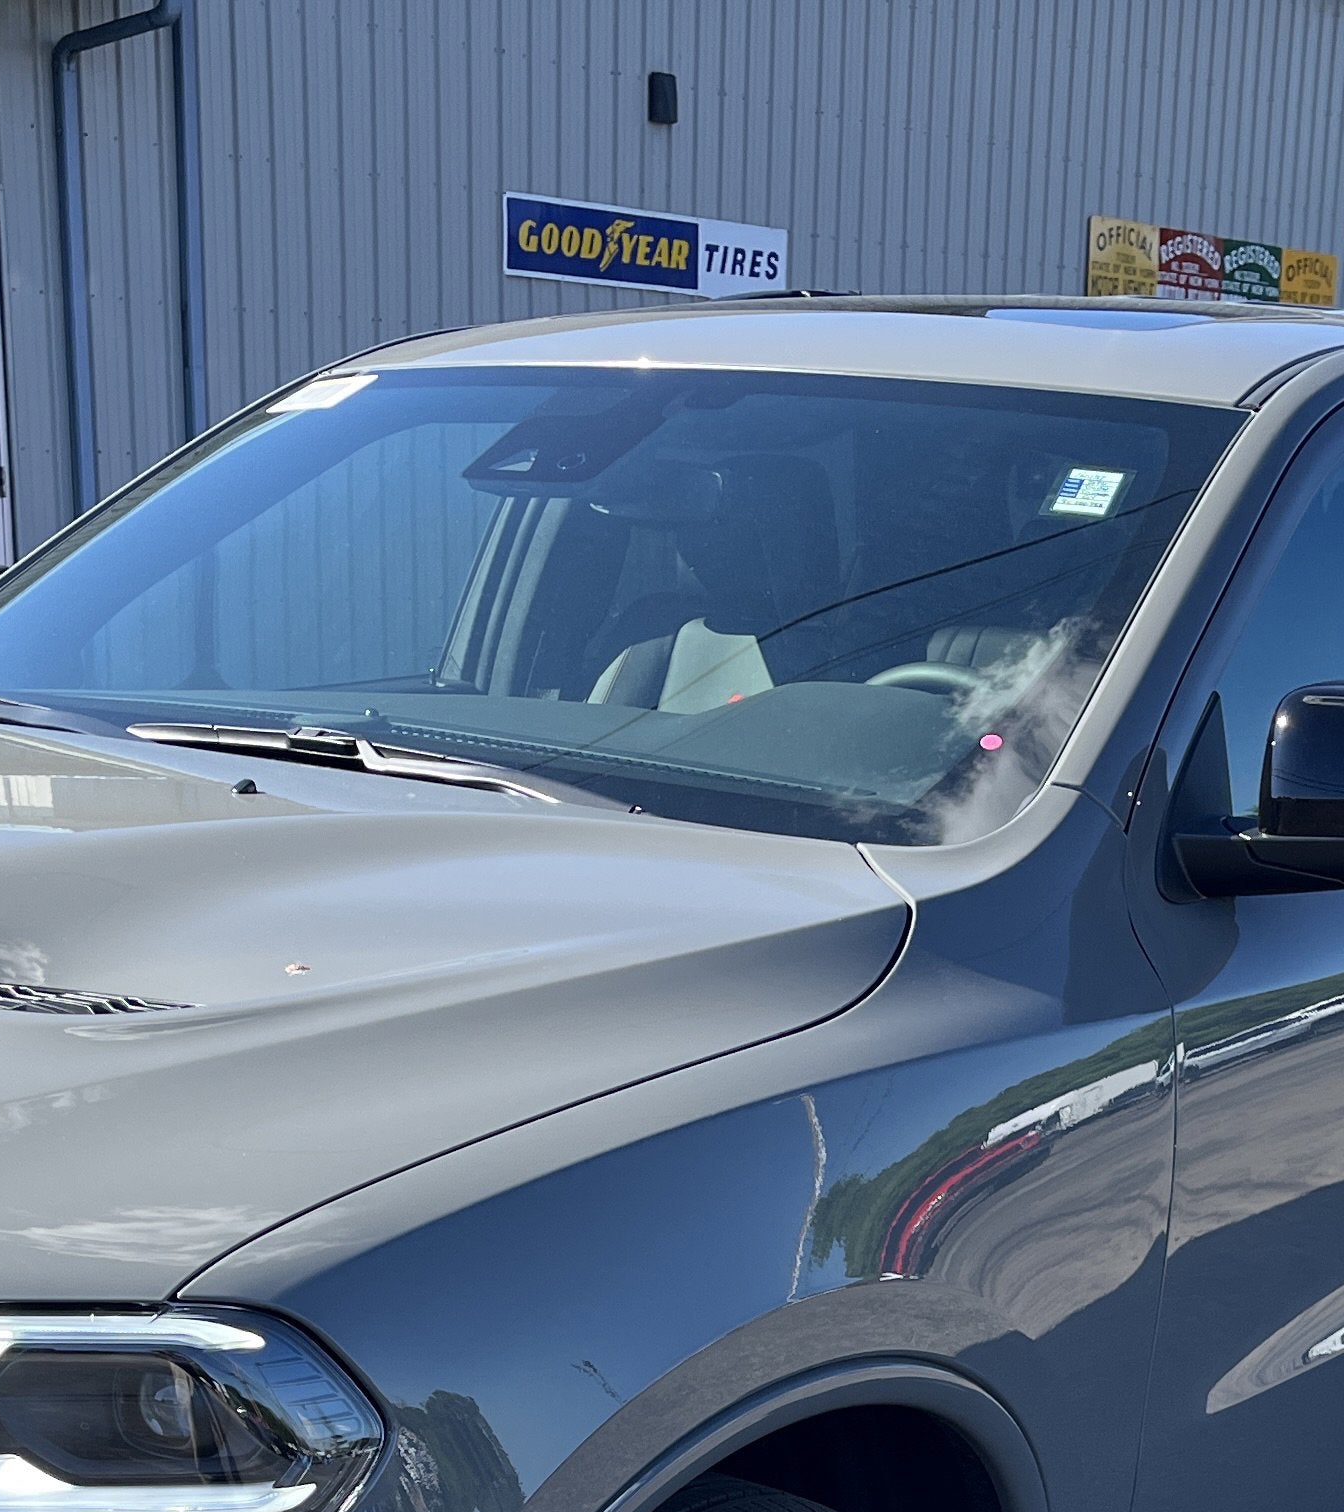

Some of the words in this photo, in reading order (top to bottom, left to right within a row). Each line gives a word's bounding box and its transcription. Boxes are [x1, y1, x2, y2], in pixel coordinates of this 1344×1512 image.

[1097, 224, 1154, 261] OFFICIAL
[1160, 234, 1222, 271] REGISTERED
[705, 243, 779, 280] TIRES
[1223, 245, 1281, 279] REGISTERED
[1286, 257, 1333, 288] OFFICIAL
